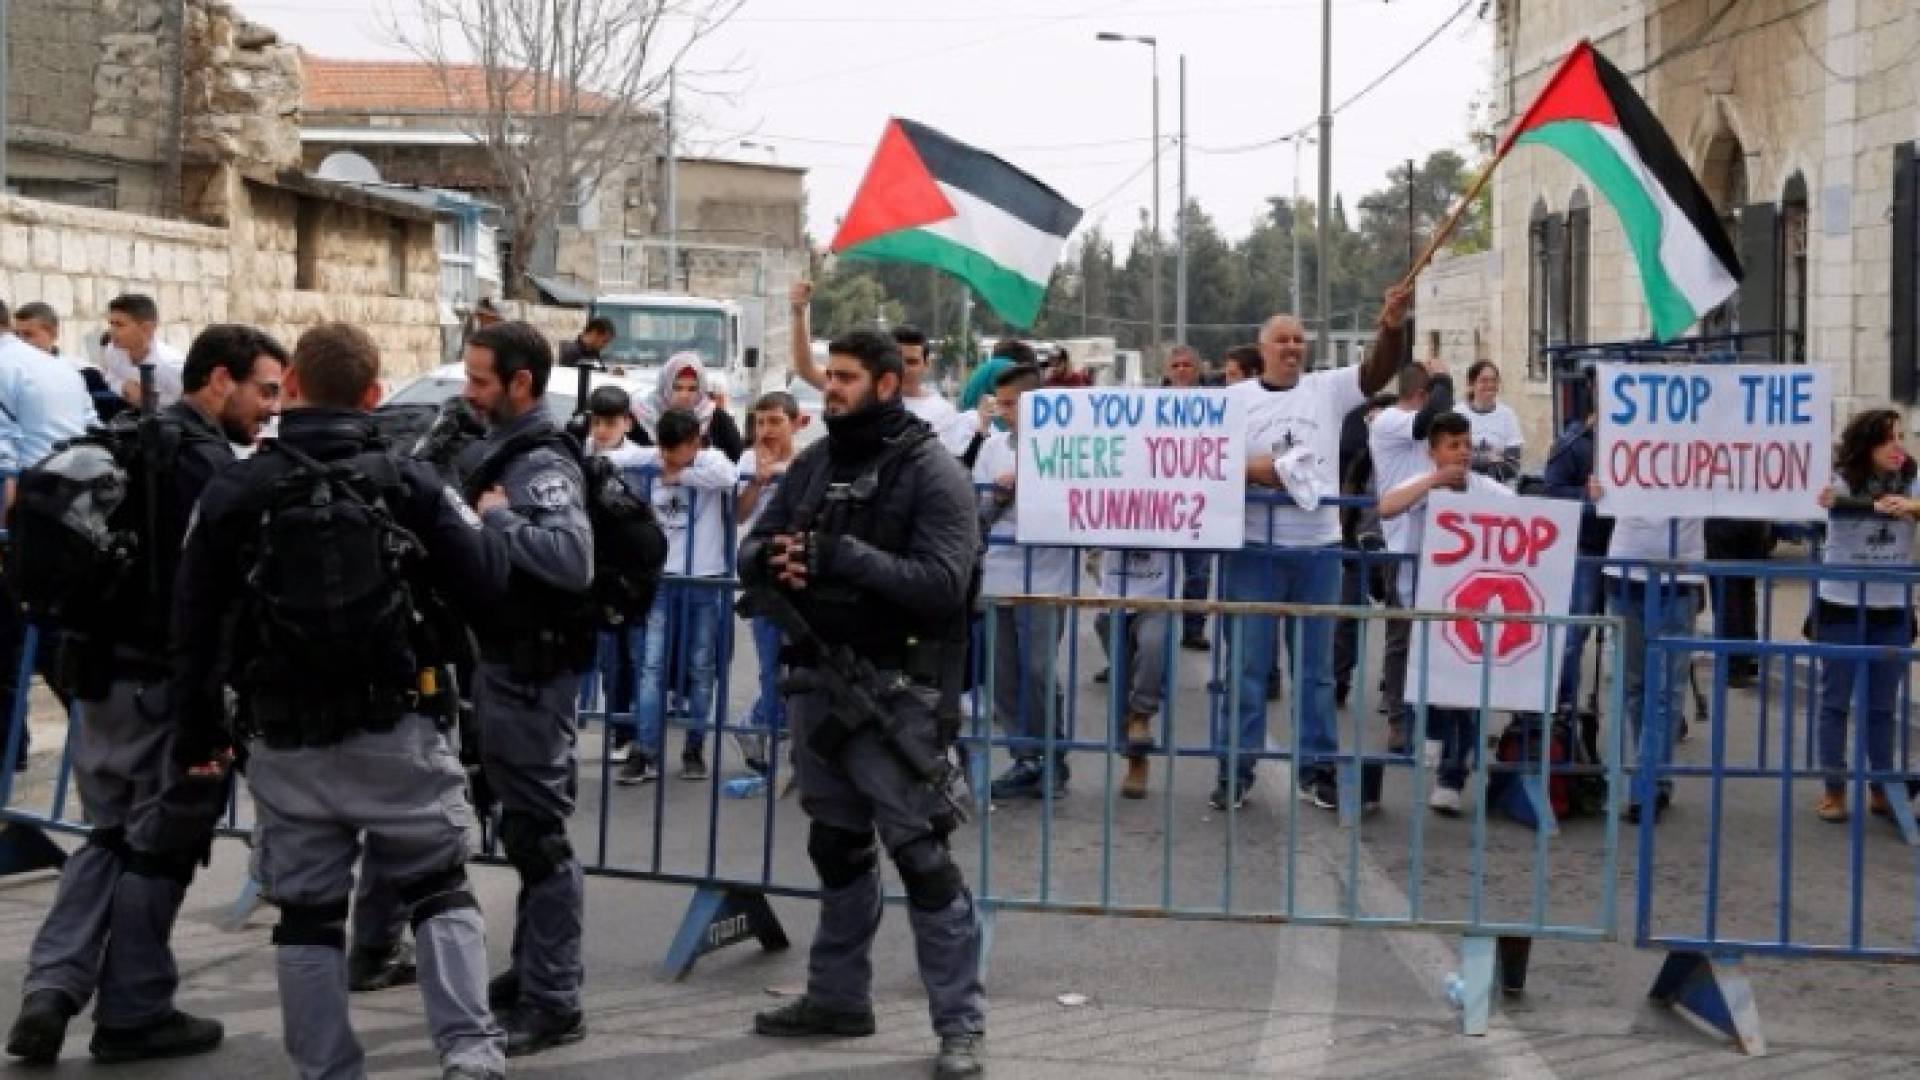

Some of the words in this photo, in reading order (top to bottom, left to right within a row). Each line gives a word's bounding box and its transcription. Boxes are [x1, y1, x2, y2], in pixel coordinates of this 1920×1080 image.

[1031, 393, 1073, 429] DO
[1088, 393, 1144, 428] YOU
[1155, 395, 1226, 428] KNOW
[1610, 372, 1712, 425] STOP
[1739, 373, 1814, 425] THE
[1029, 434, 1126, 479] WHERE
[1610, 440, 1812, 492] OCCUPATION
[1067, 488, 1206, 540] RUNNING?
[1431, 511, 1559, 567] STOP
